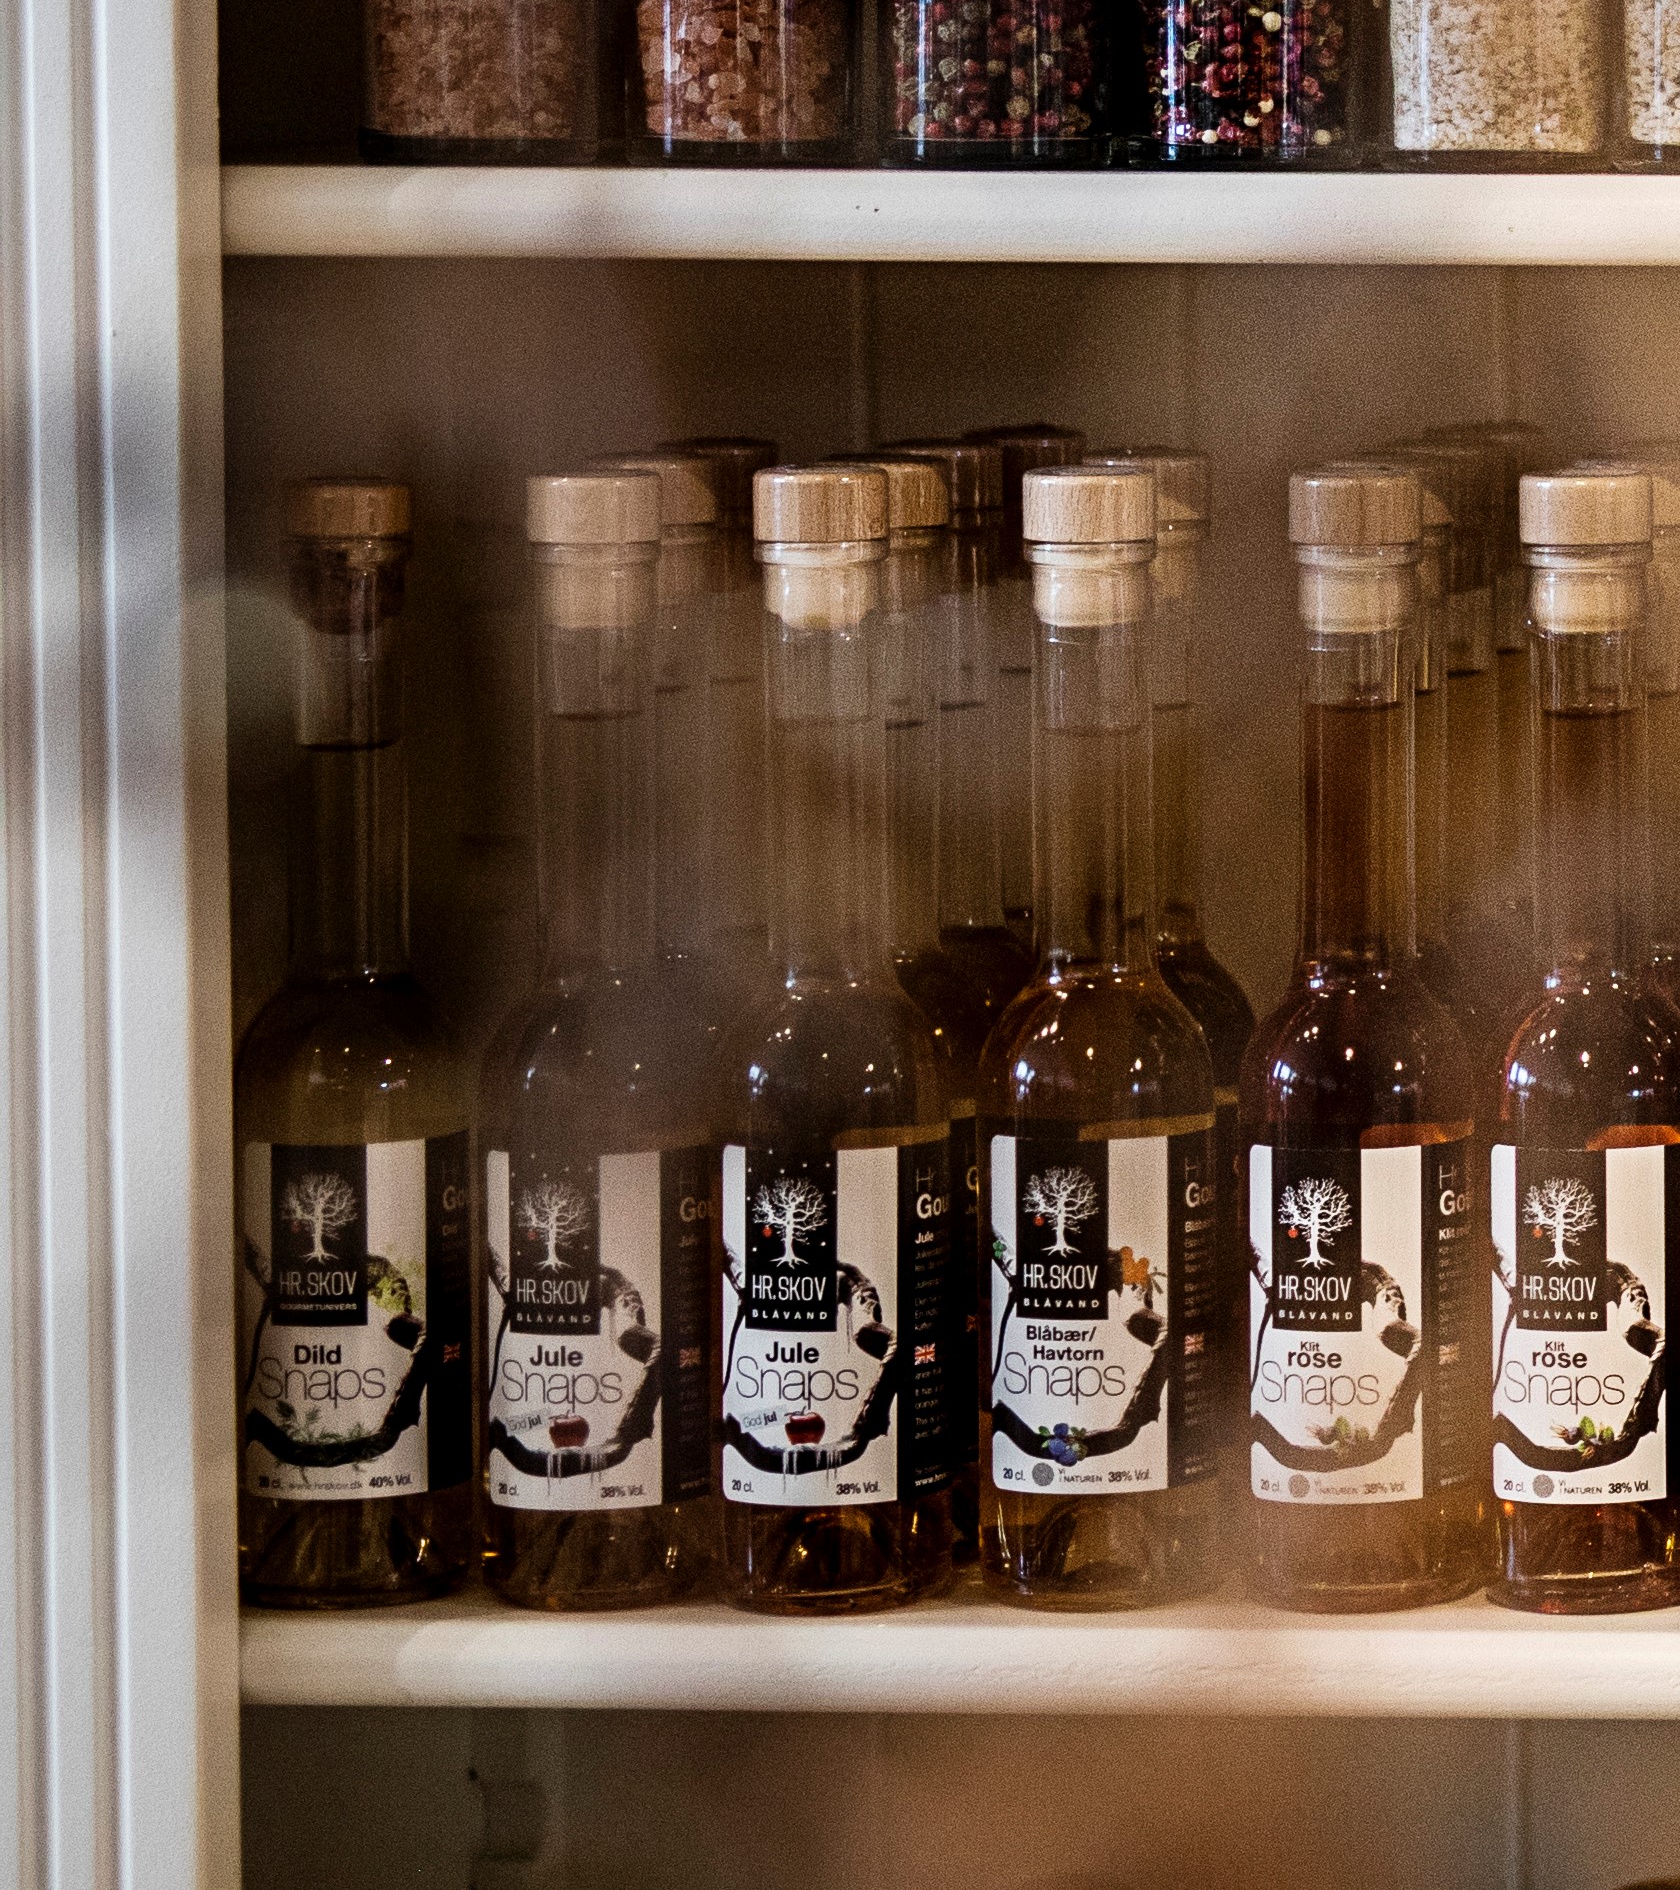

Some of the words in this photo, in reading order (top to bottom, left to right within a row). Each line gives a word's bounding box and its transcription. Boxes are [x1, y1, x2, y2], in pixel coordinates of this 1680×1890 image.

[1025, 1325, 1096, 1345] Blåbær/
[293, 1344, 342, 1364] Dild
[764, 1340, 819, 1364] Jule
[1032, 1344, 1104, 1361] Havtorn
[1531, 1349, 1587, 1369] rose
[258, 1355, 386, 1410] Snaps
[735, 1355, 859, 1410] Snaps
[1003, 1351, 1125, 1405] Snaps
[1504, 1360, 1625, 1414] Snaps
